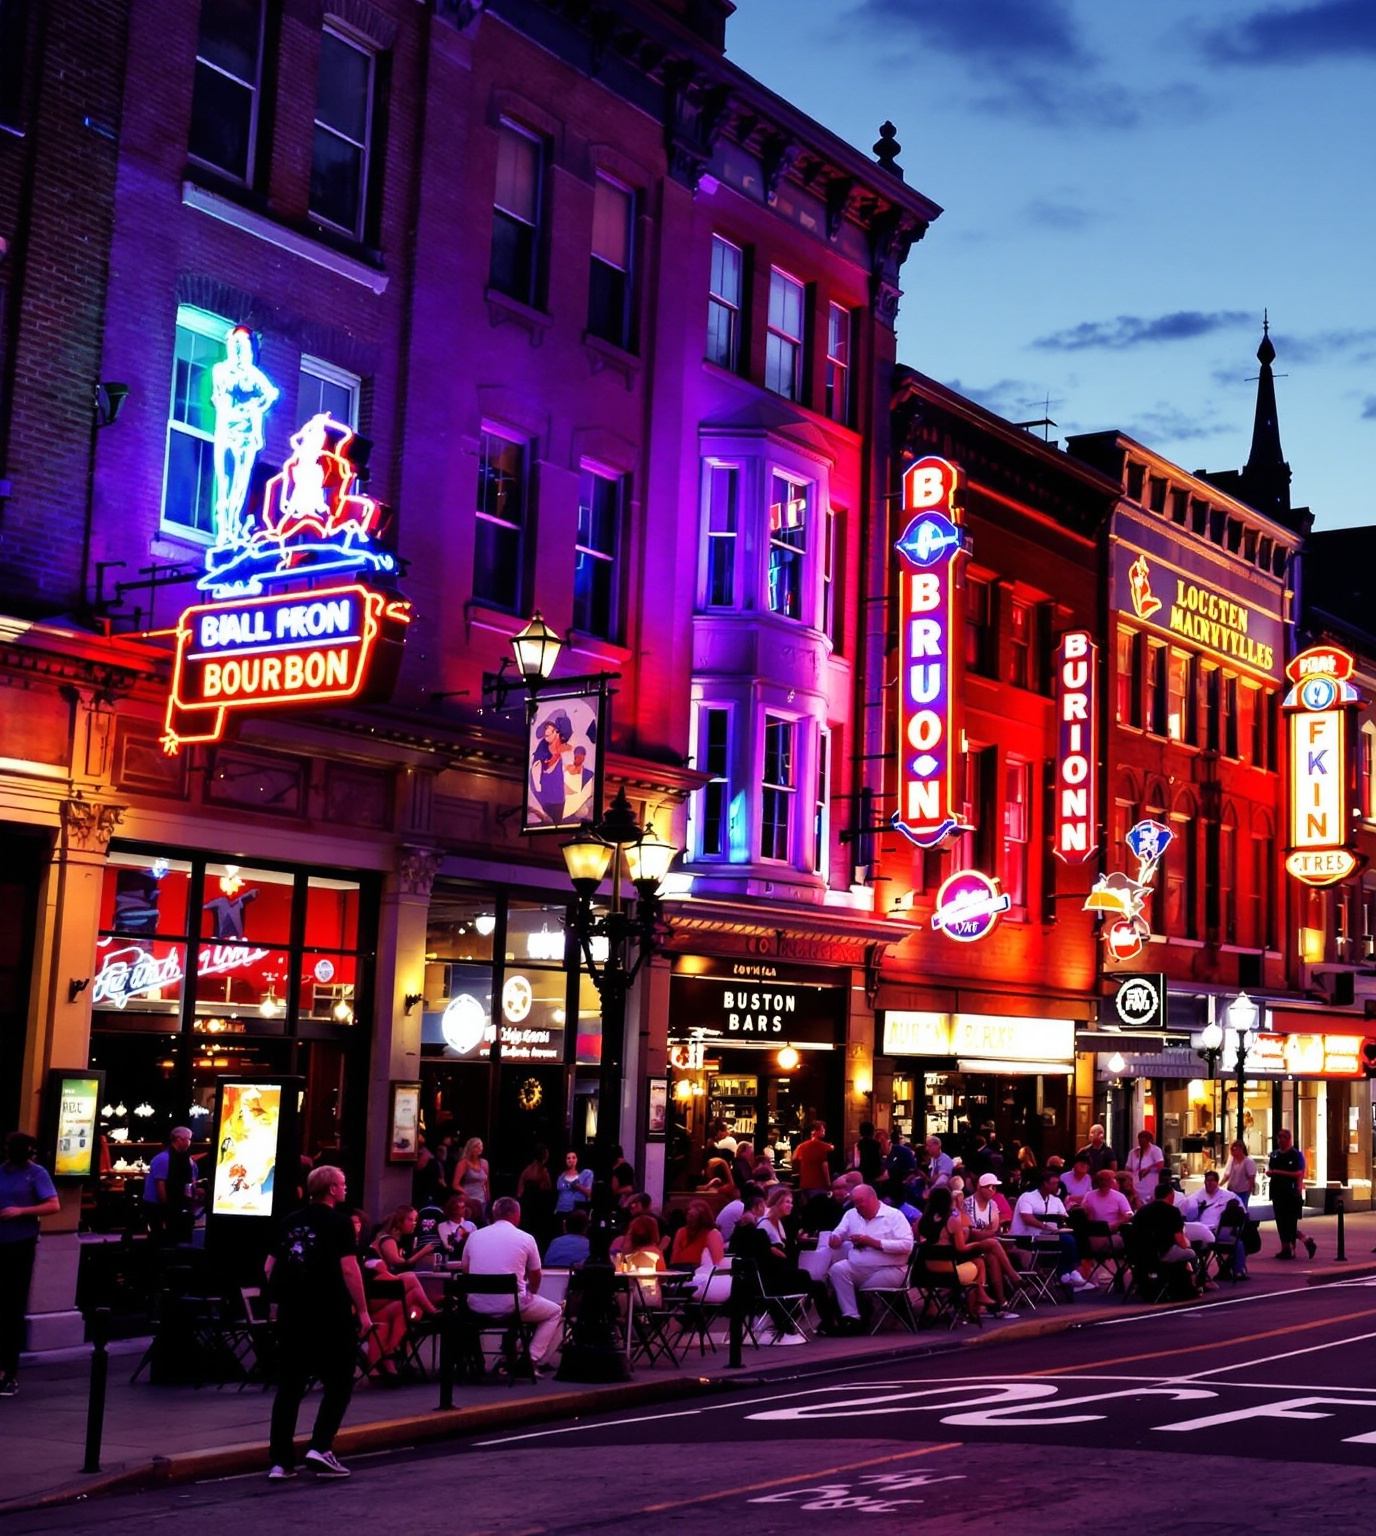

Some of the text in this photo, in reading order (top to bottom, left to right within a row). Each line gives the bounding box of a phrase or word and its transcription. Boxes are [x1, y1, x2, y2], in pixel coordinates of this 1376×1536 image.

[203, 649, 349, 697] BOURBON
[1061, 633, 1089, 851] BURIONN
[723, 991, 795, 1012] BUSTON
[729, 1014, 783, 1032] BARS
